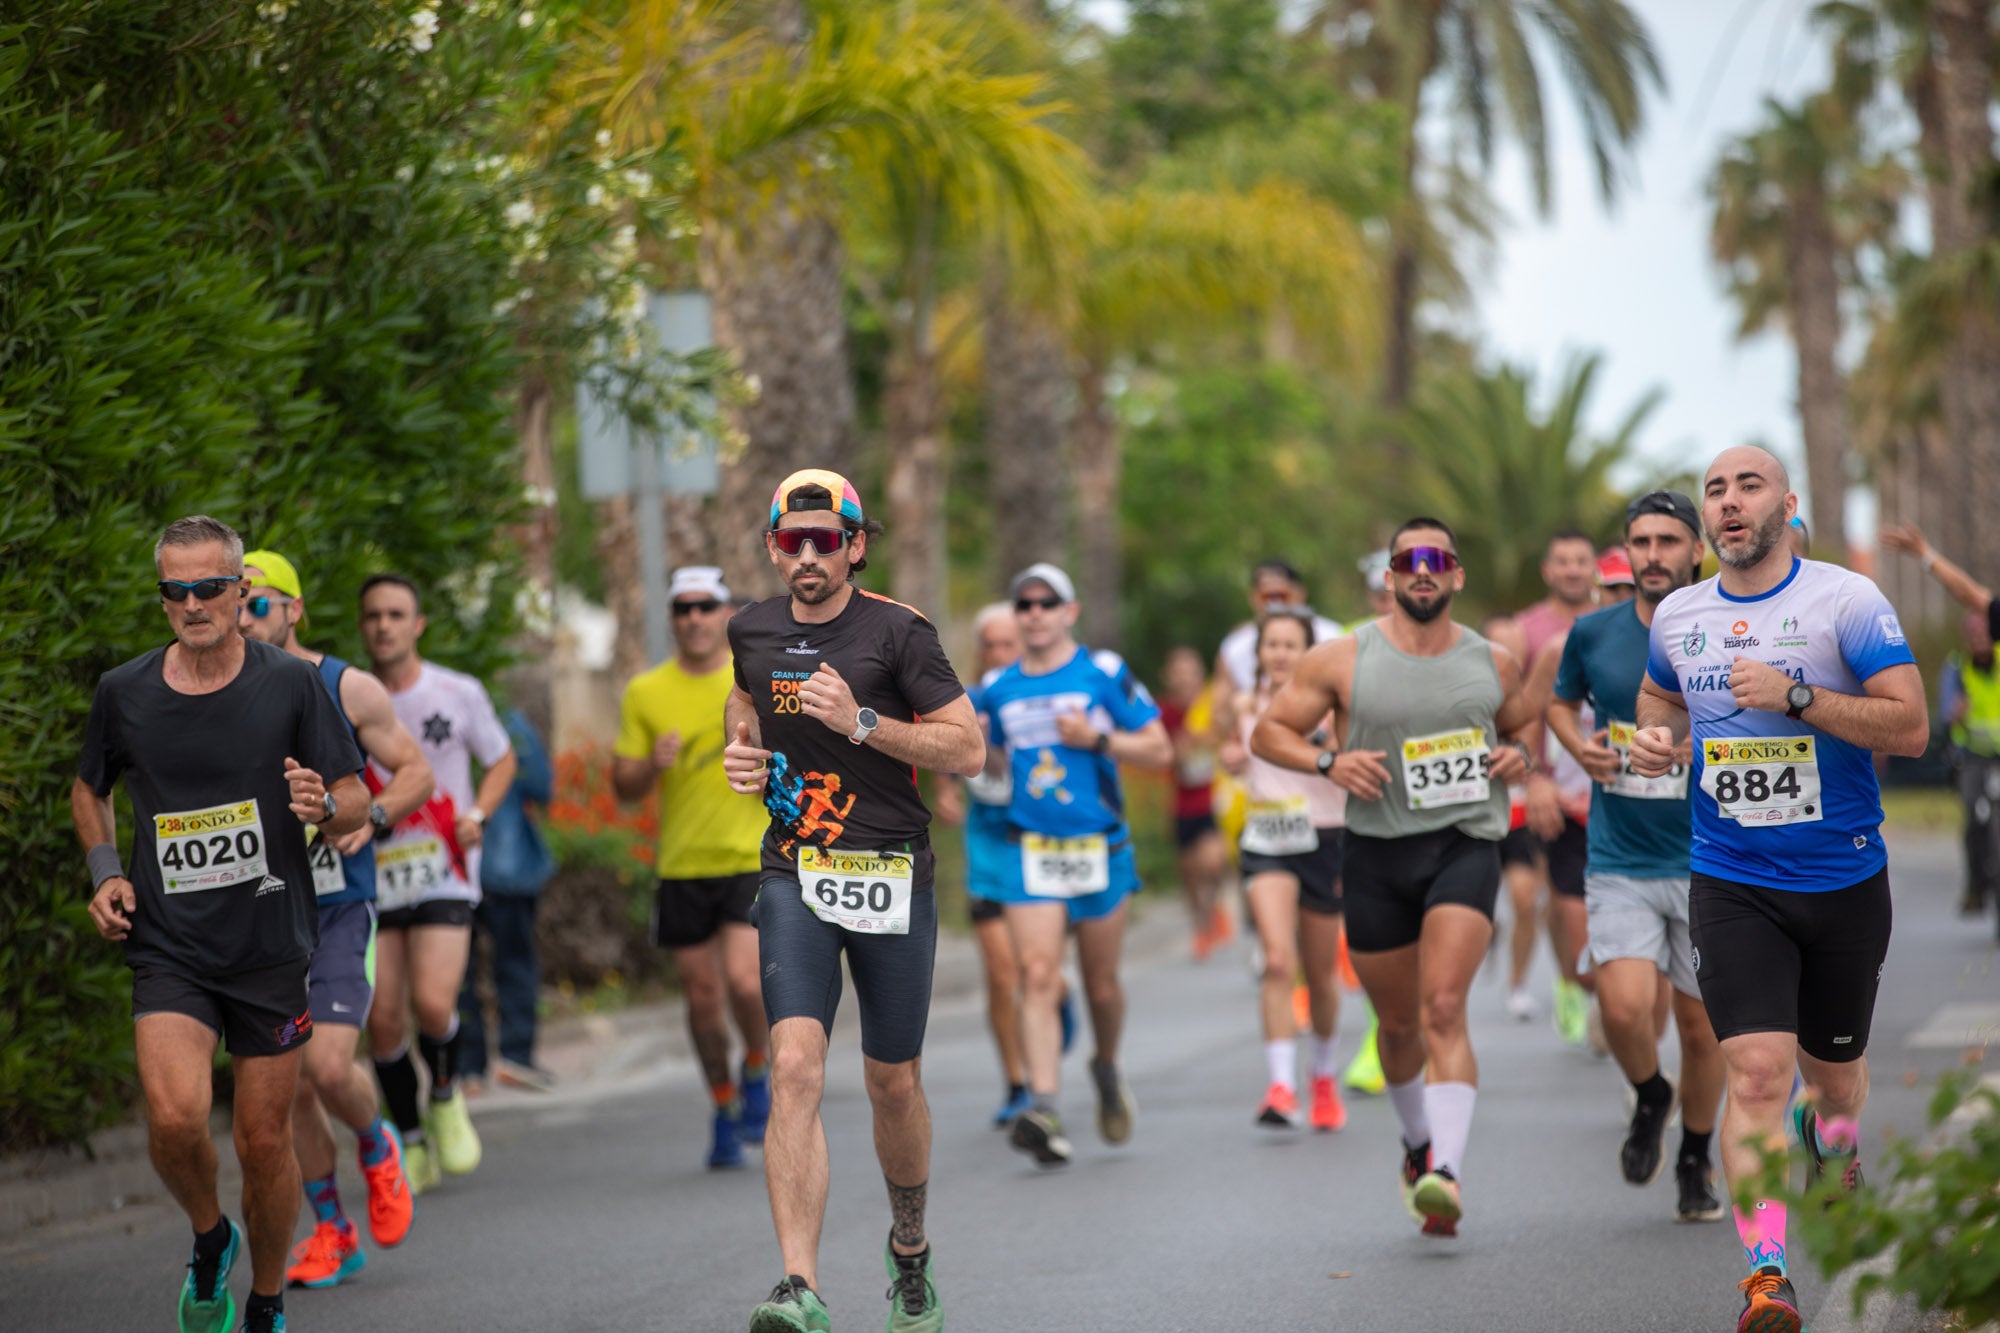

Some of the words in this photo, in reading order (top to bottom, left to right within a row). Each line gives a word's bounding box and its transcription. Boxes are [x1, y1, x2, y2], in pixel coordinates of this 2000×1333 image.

[1724, 636, 1760, 649] mayfo
[771, 671, 794, 679] GRAN
[1698, 665, 1721, 673] CLUB
[1716, 743, 1730, 759] 38
[1730, 747, 1789, 760] FONDO
[1410, 753, 1489, 790] 3325
[1715, 766, 1801, 803] 884
[166, 818, 182, 832] 38
[181, 814, 235, 832] FONDO
[161, 830, 259, 871] 4020
[814, 853, 832, 868] 38
[832, 859, 888, 873] FONDO
[815, 878, 892, 913] 650
